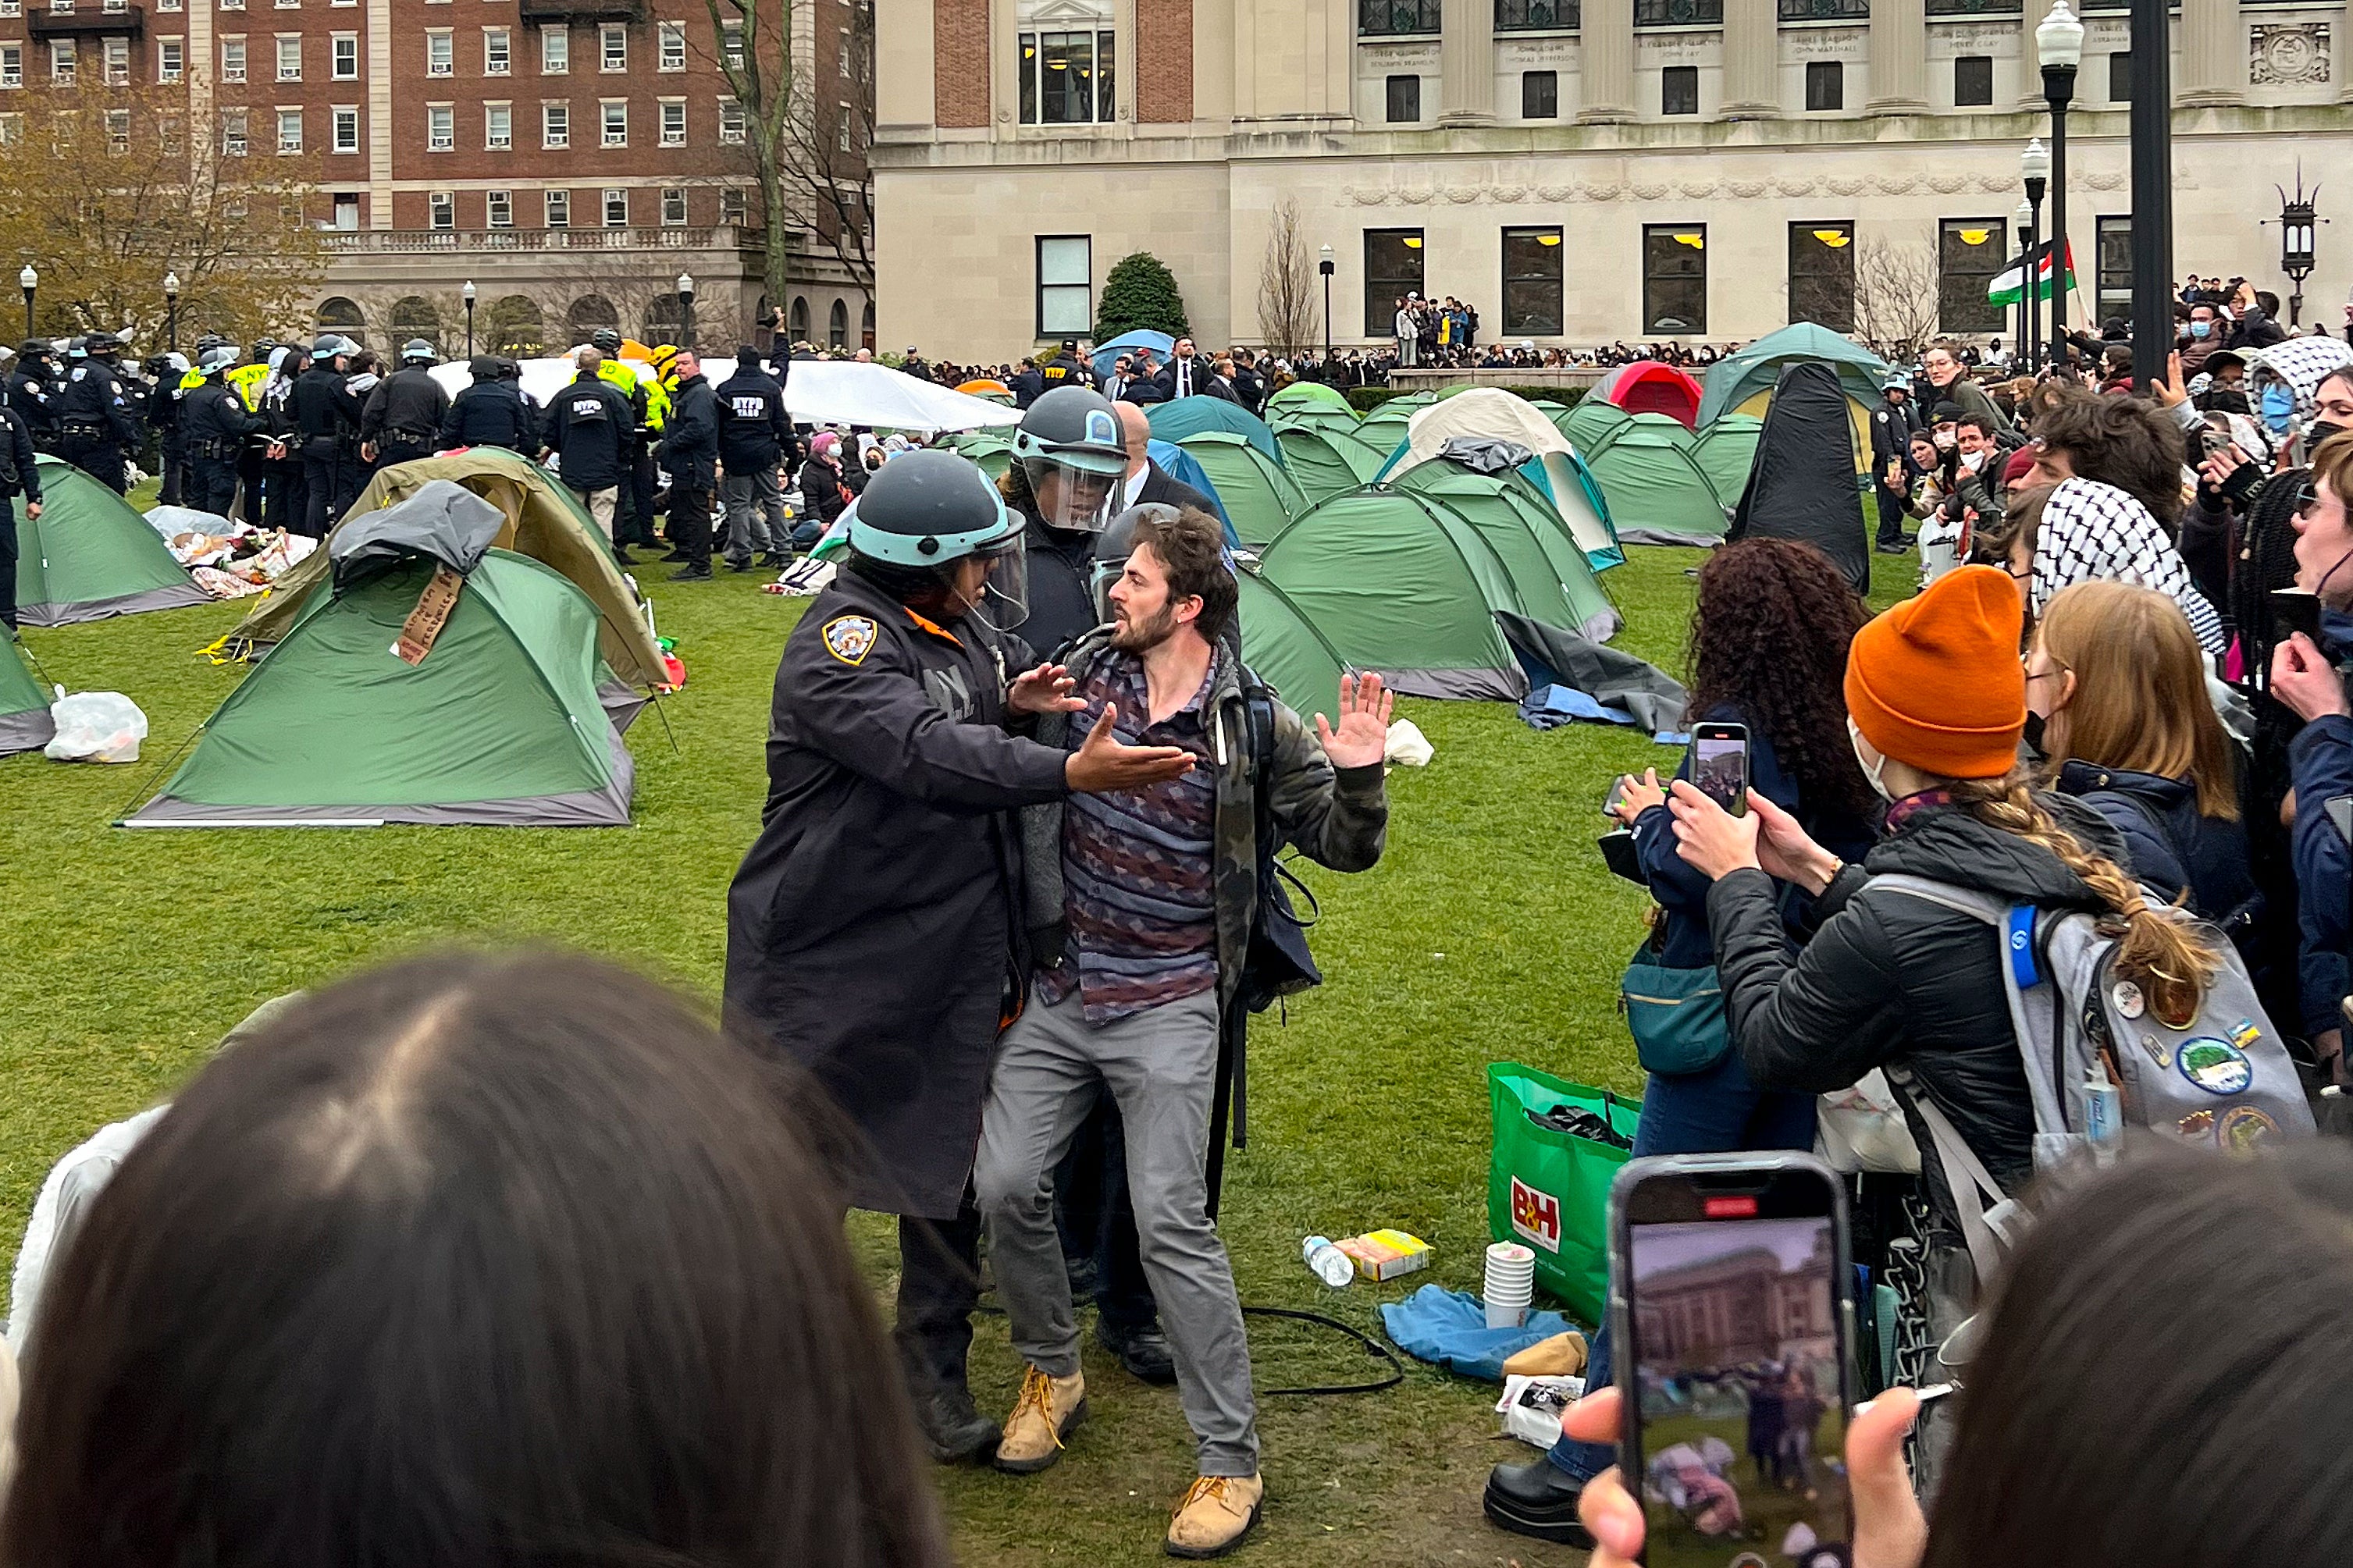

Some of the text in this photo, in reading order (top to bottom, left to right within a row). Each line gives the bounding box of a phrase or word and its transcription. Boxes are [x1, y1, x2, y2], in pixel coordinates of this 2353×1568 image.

[572, 400, 603, 412] NYPD
[732, 396, 764, 410] NYPD
[1513, 1181, 1557, 1240] B&H
